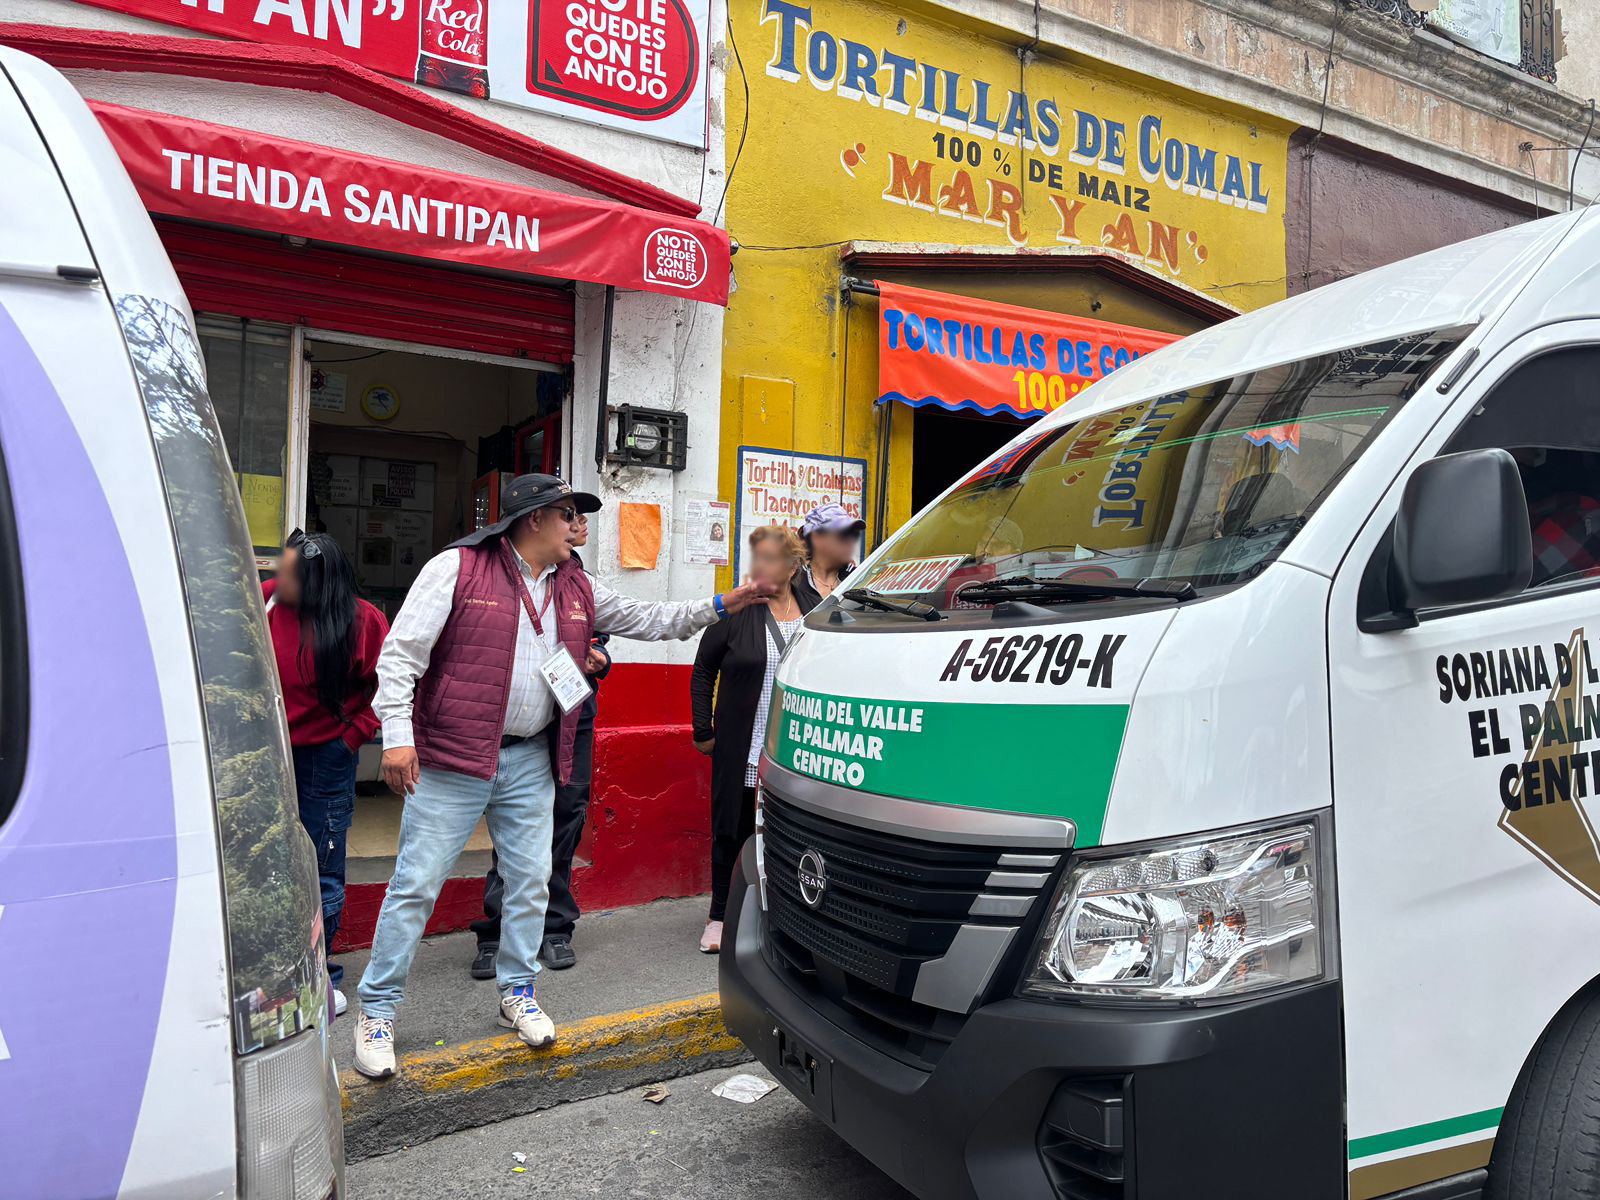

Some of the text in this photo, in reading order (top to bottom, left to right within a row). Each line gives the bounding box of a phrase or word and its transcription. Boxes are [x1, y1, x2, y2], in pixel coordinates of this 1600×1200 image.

[426, 0, 483, 35] Red
[565, 3, 666, 51] QUEDES
[437, 29, 480, 57] Cola
[565, 28, 667, 78] CON EL
[563, 55, 668, 100] ANTOJO
[761, 0, 1271, 213] TORTILLAS DE COMAL
[932, 132, 1151, 213] 100 % DE MAIZ
[161, 148, 541, 253] TIENDA SANTIPAN
[1048, 194, 1087, 245] Y
[656, 246, 697, 263] QUEDES
[656, 256, 697, 274] CON EL
[657, 233, 697, 253] NO TE
[656, 267, 698, 283] ANTOJO
[884, 309, 1047, 371] TORTILLAS
[1057, 337, 1093, 377] DE
[745, 458, 797, 487] Tortilla
[939, 634, 1127, 689] A-56219-K
[1436, 644, 1552, 704] SORIANA
[781, 690, 924, 733] SORIANA DEL VALLE
[1468, 708, 1511, 758] EL
[788, 719, 883, 761] EL PALMAR
[792, 748, 865, 787] CENTRO
